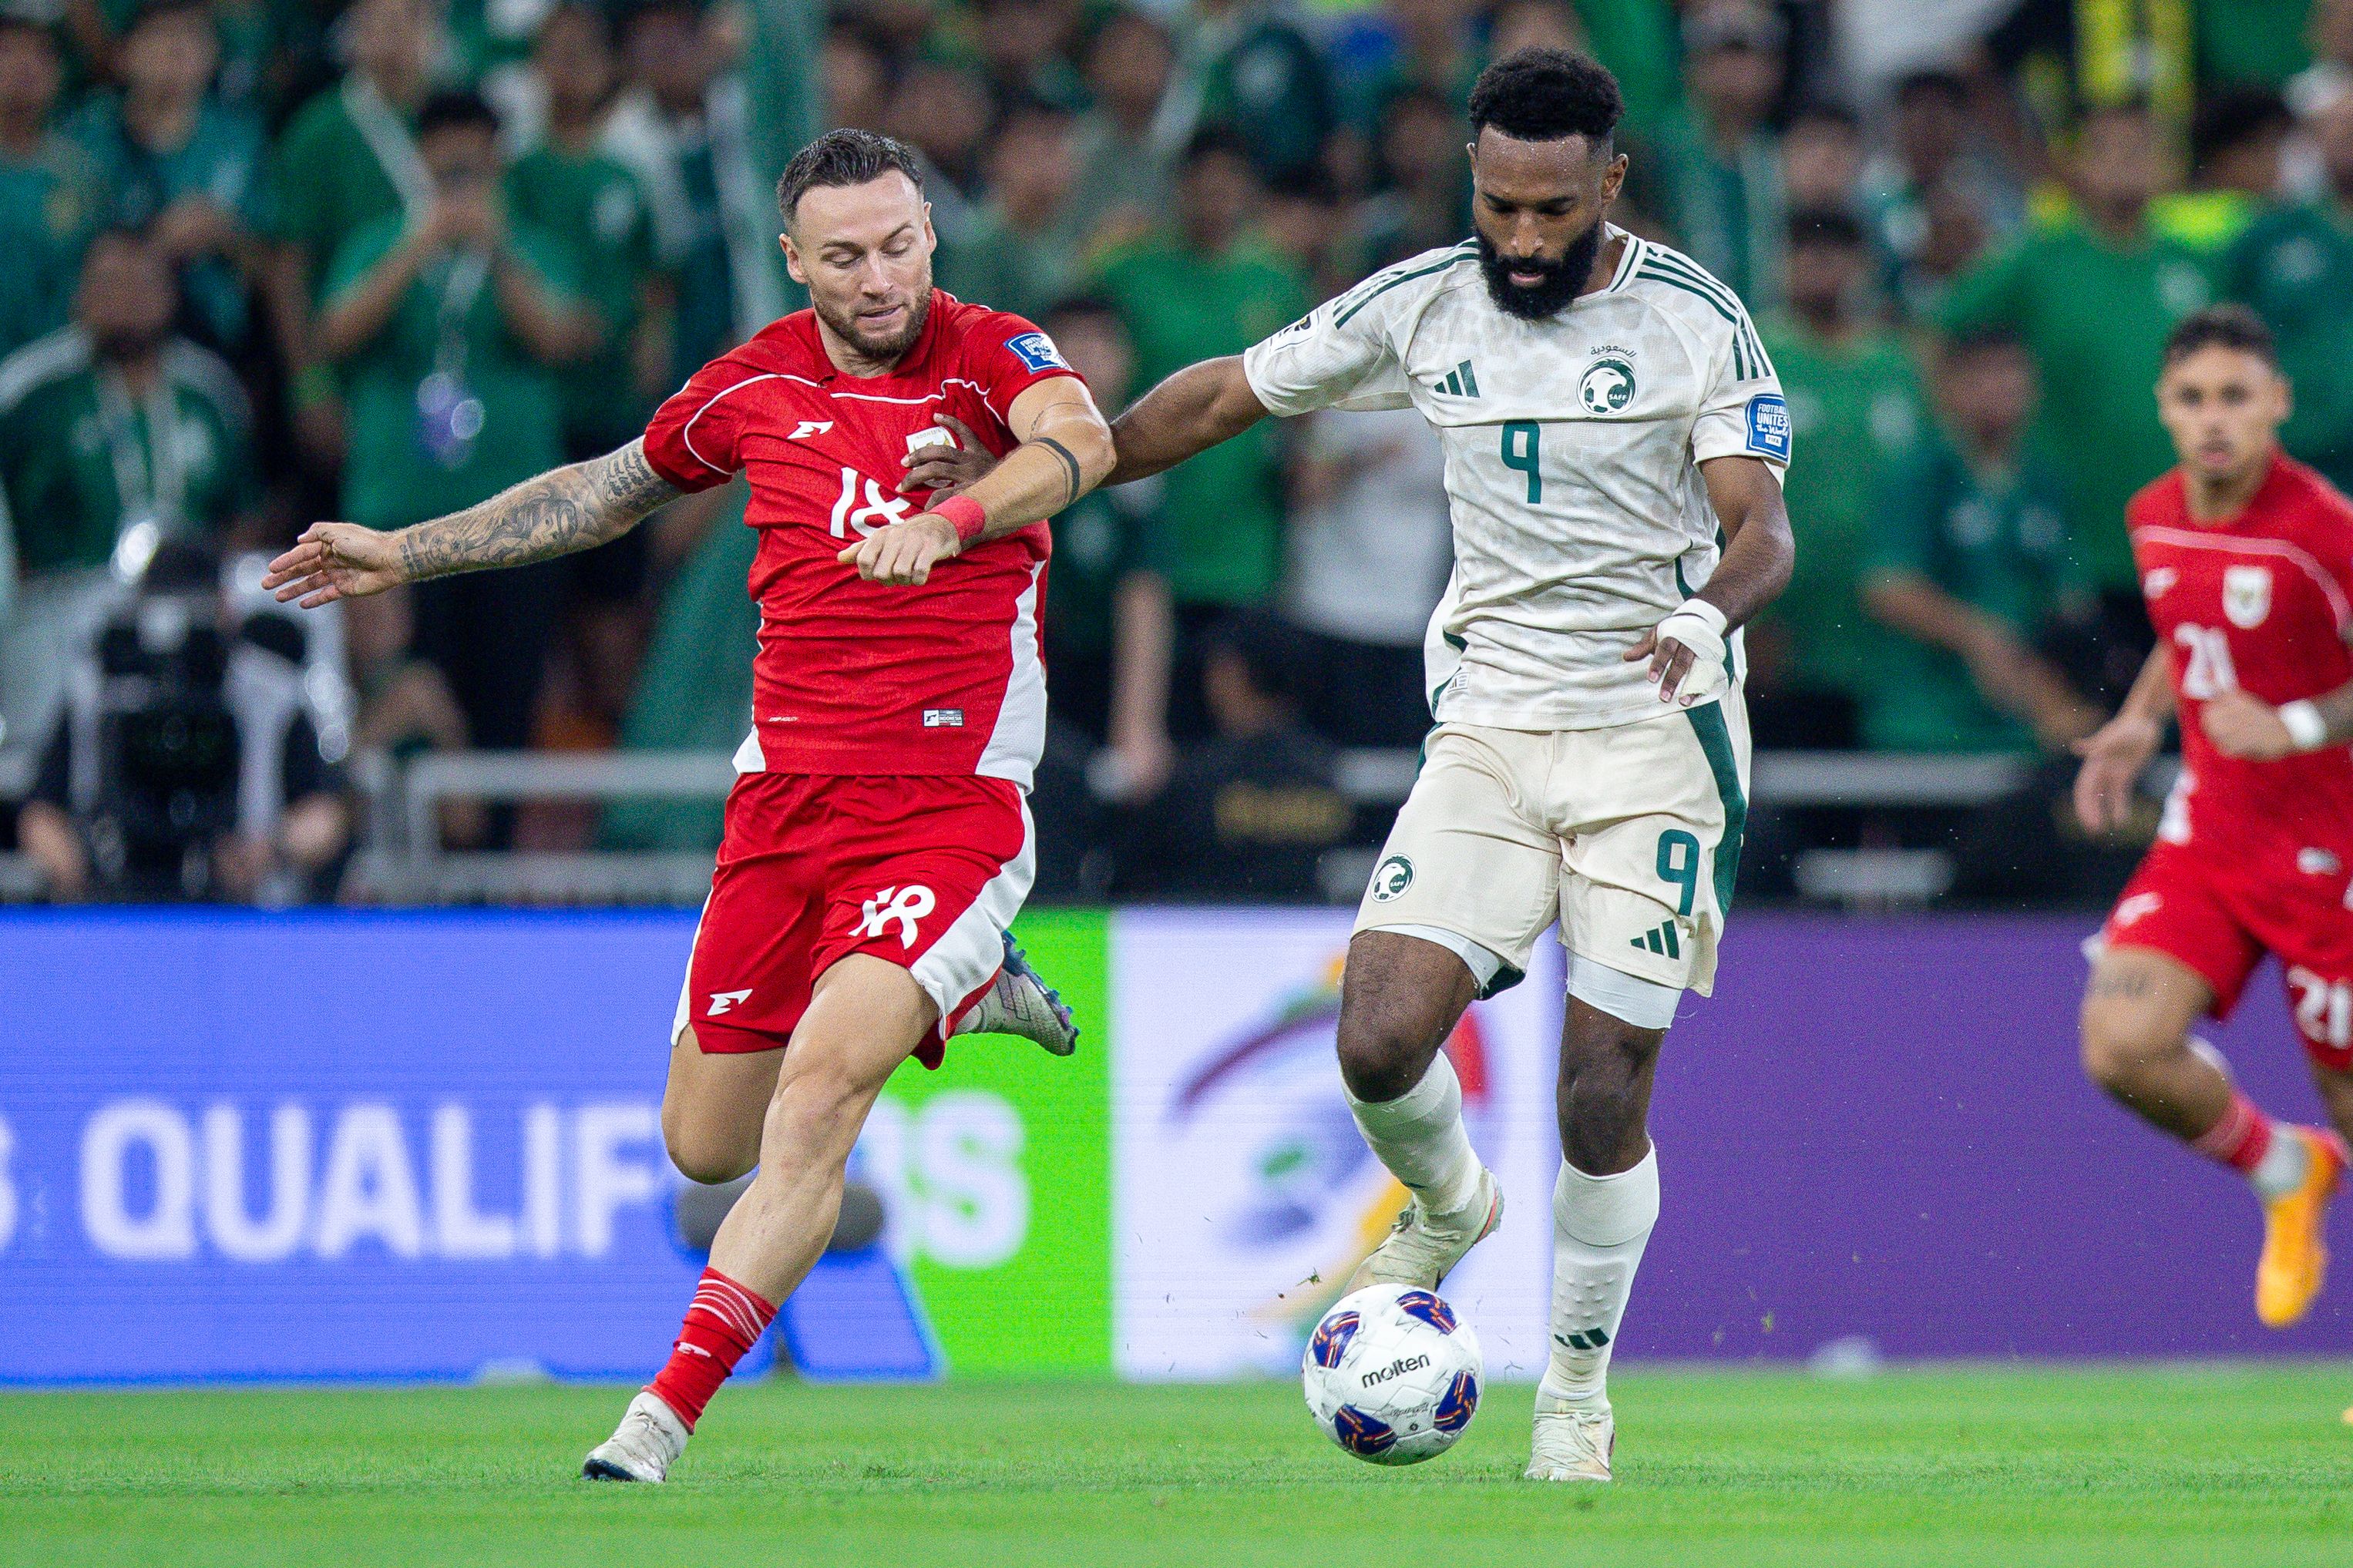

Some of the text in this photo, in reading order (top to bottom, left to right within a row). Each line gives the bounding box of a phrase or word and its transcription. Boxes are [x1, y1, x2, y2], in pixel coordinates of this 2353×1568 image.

[1591, 345, 1637, 358] السعودية
[1757, 412, 1788, 427] UNITES
[1501, 419, 1541, 504] 9
[830, 467, 911, 539] 18
[1656, 828, 1700, 917] 9
[848, 885, 936, 951] 18
[2286, 965, 2352, 1050] 21
[1362, 1354, 1430, 1388] molten
